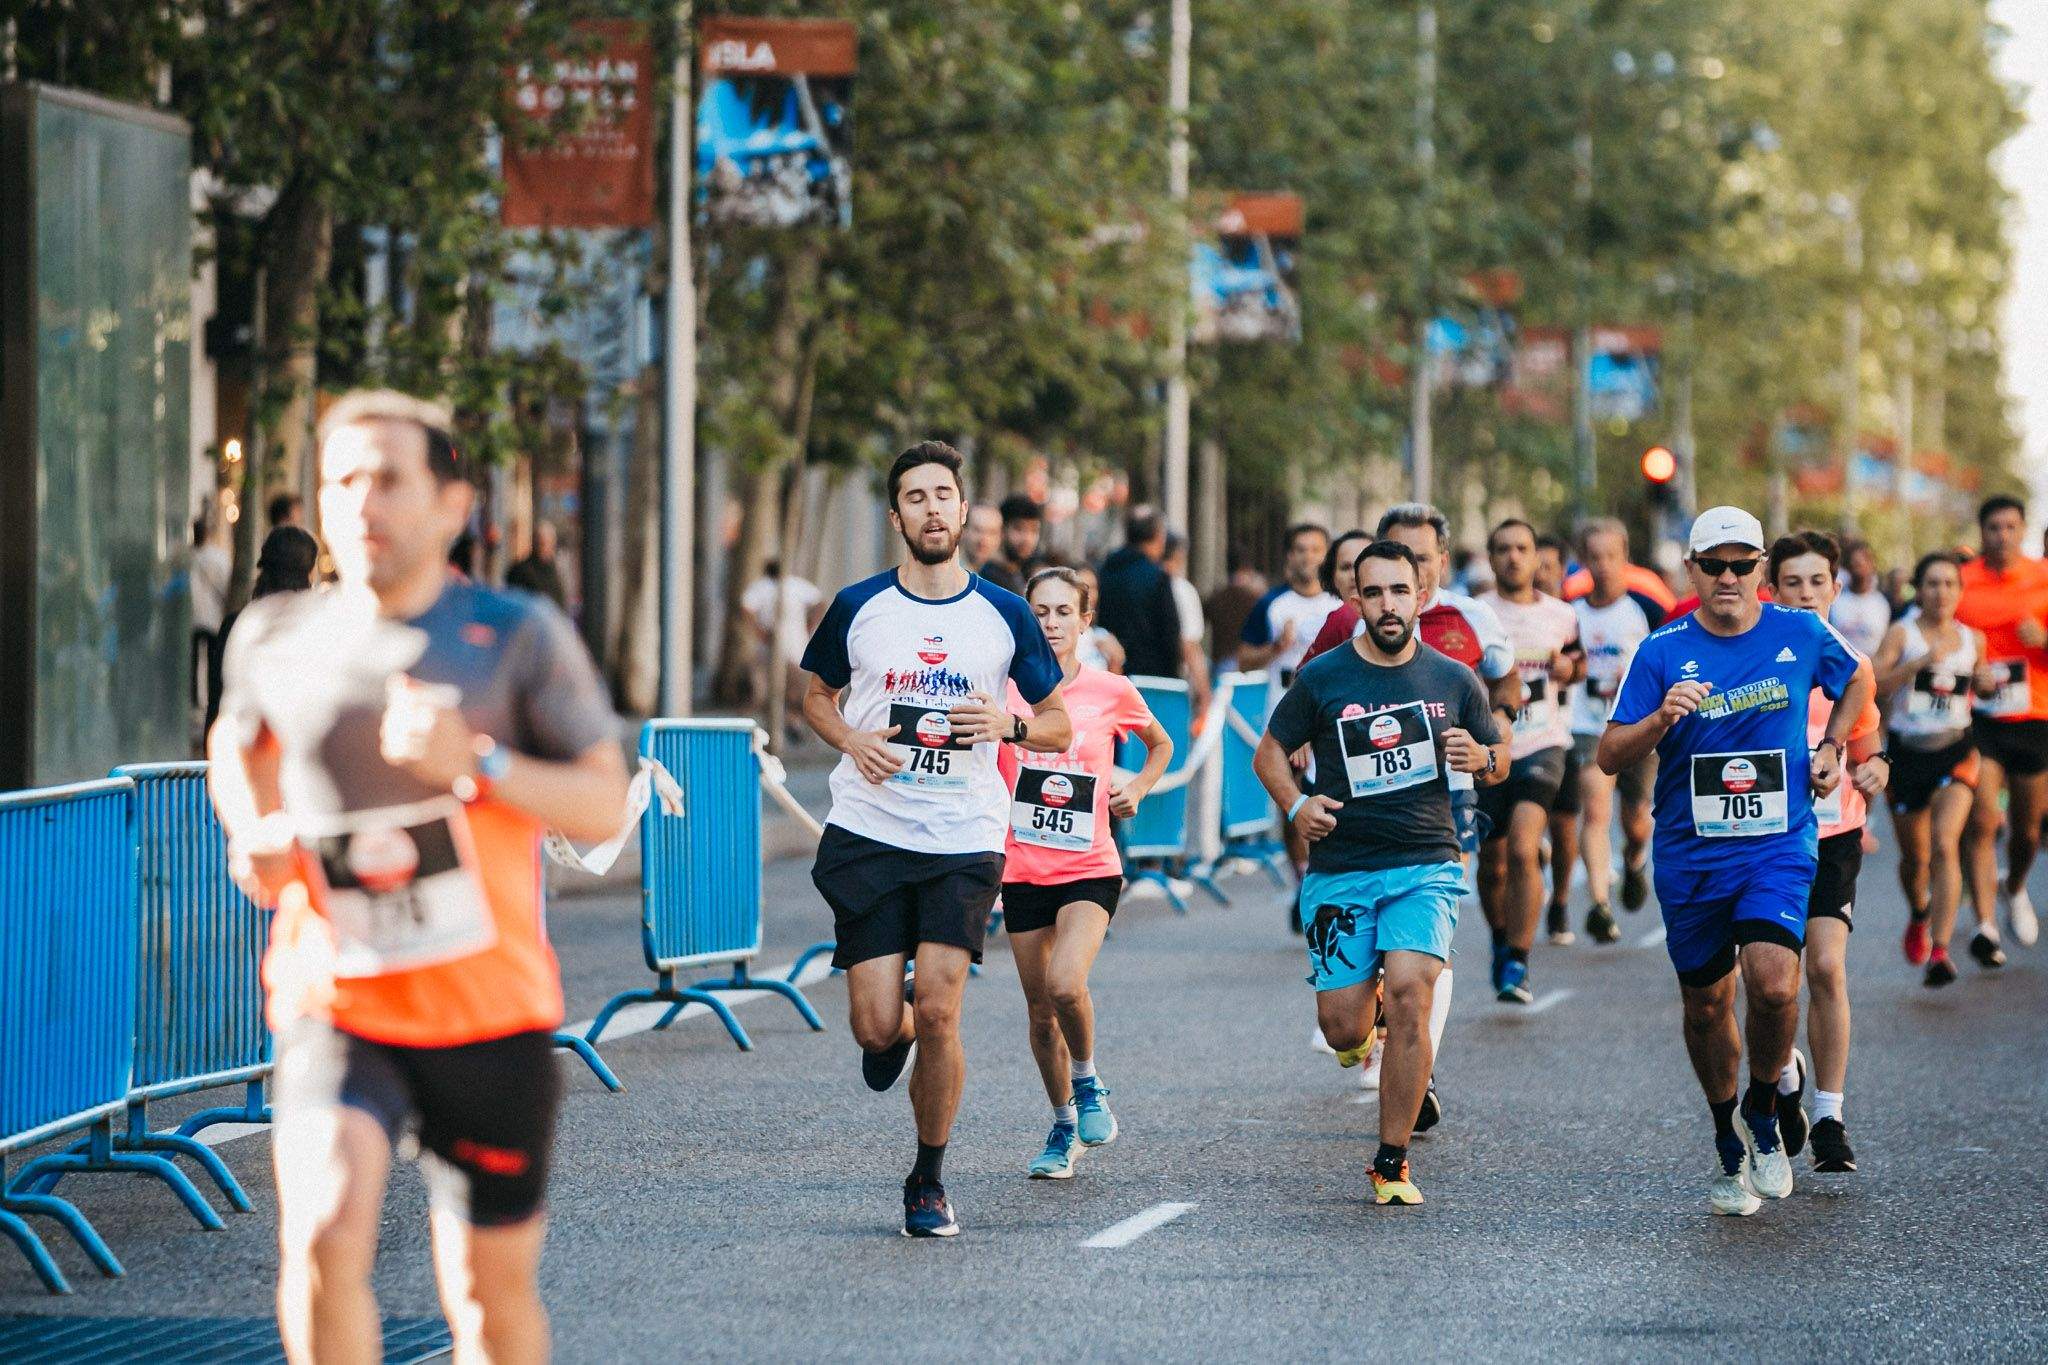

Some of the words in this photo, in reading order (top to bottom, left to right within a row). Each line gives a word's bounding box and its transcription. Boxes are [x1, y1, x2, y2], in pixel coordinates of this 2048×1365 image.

[1728, 677, 1779, 700] MADRID
[1709, 705, 1733, 720] ROLL
[910, 747, 950, 775] 745
[1370, 747, 1412, 777] 783
[1032, 806, 1074, 834] 545
[1719, 794, 1763, 820] 705
